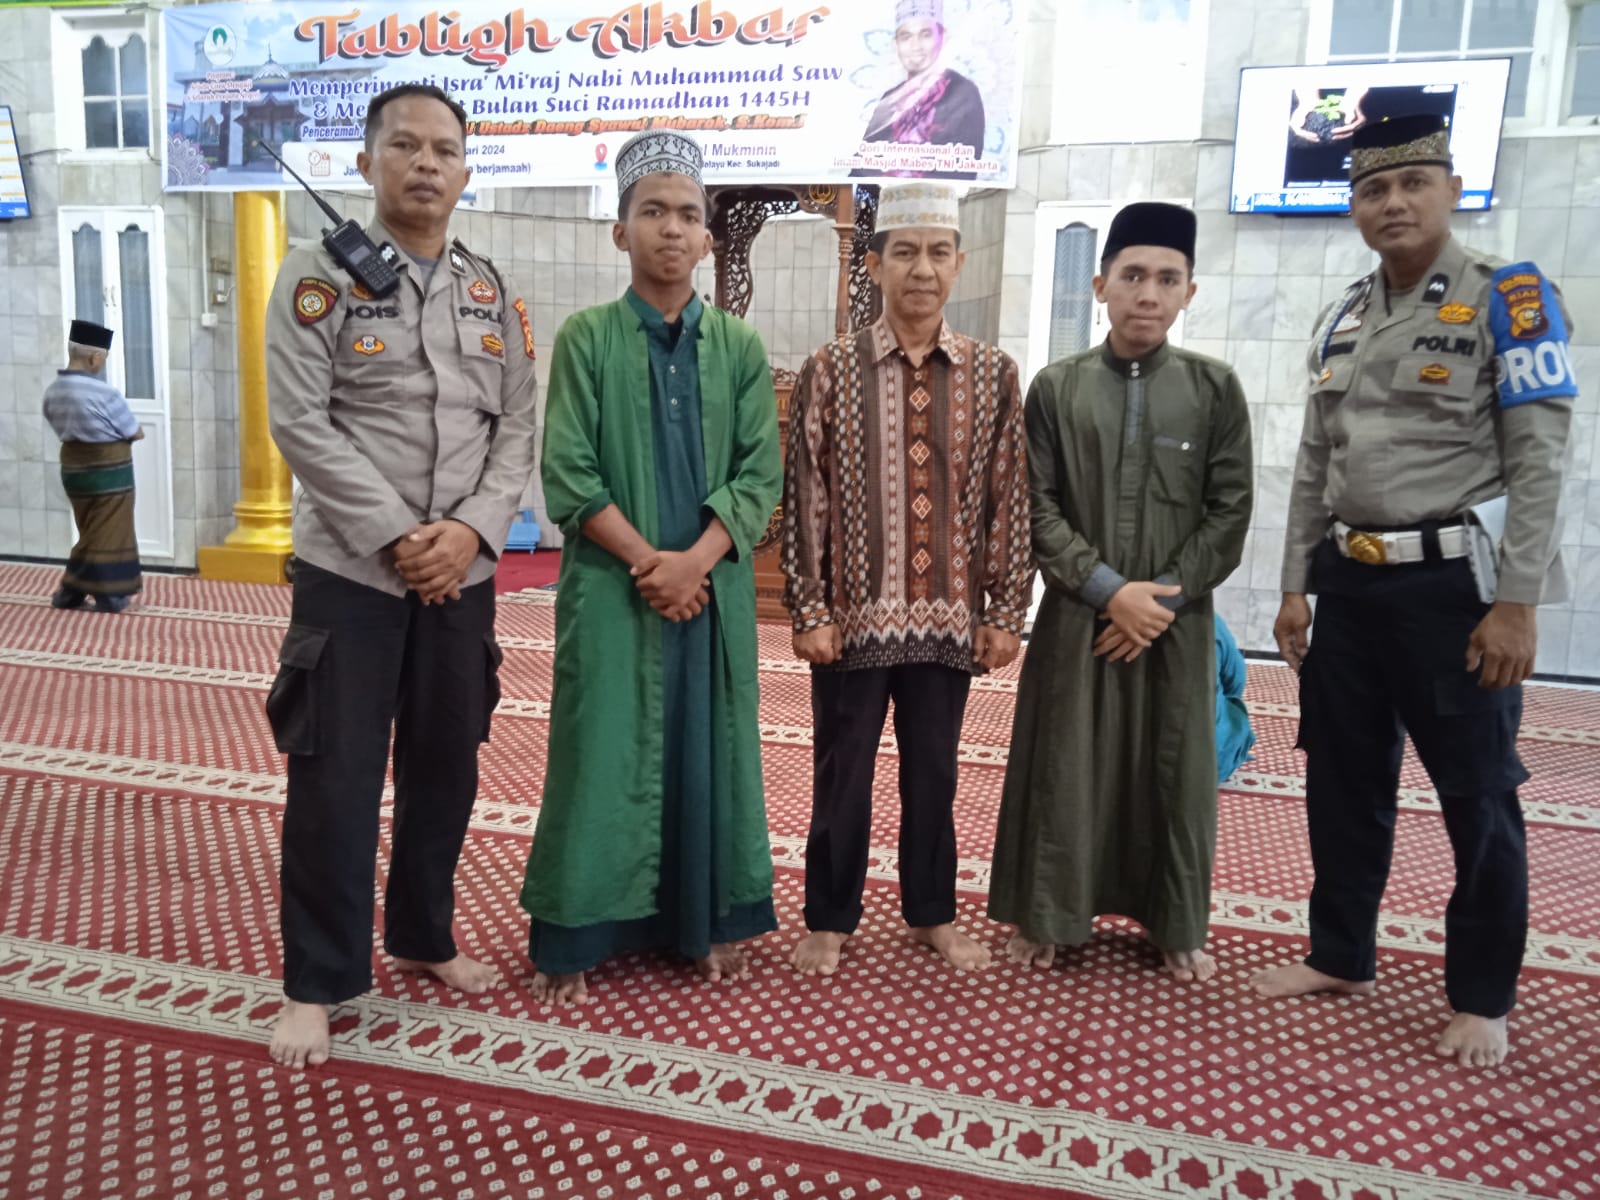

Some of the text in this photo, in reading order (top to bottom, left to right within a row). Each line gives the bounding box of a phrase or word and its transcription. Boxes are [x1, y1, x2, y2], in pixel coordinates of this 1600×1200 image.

[295, 0, 831, 72] Tabligh Akbar
[495, 71, 560, 94] Mi'raj
[568, 69, 622, 88] Nabi
[631, 64, 784, 86] Muhammad
[793, 64, 843, 82] Saw
[472, 99, 538, 115] Bulan
[545, 94, 589, 112] Suci
[596, 91, 730, 111] Ramadhan
[740, 90, 810, 108] 1445H
[313, 102, 328, 119] &
[302, 125, 359, 138] Penceramah
[534, 119, 584, 137] Daeng
[482, 145, 505, 155] 2024
[712, 144, 777, 156] Mukminin
[883, 144, 950, 155] Internasional
[954, 144, 973, 155] dan
[477, 163, 531, 177] berjamaah)
[746, 159, 780, 171] Sukajadi
[864, 157, 897, 169] Masjid
[900, 158, 932, 168] Mabes
[957, 159, 998, 170] Jakarta
[1413, 336, 1476, 356] POLRI
